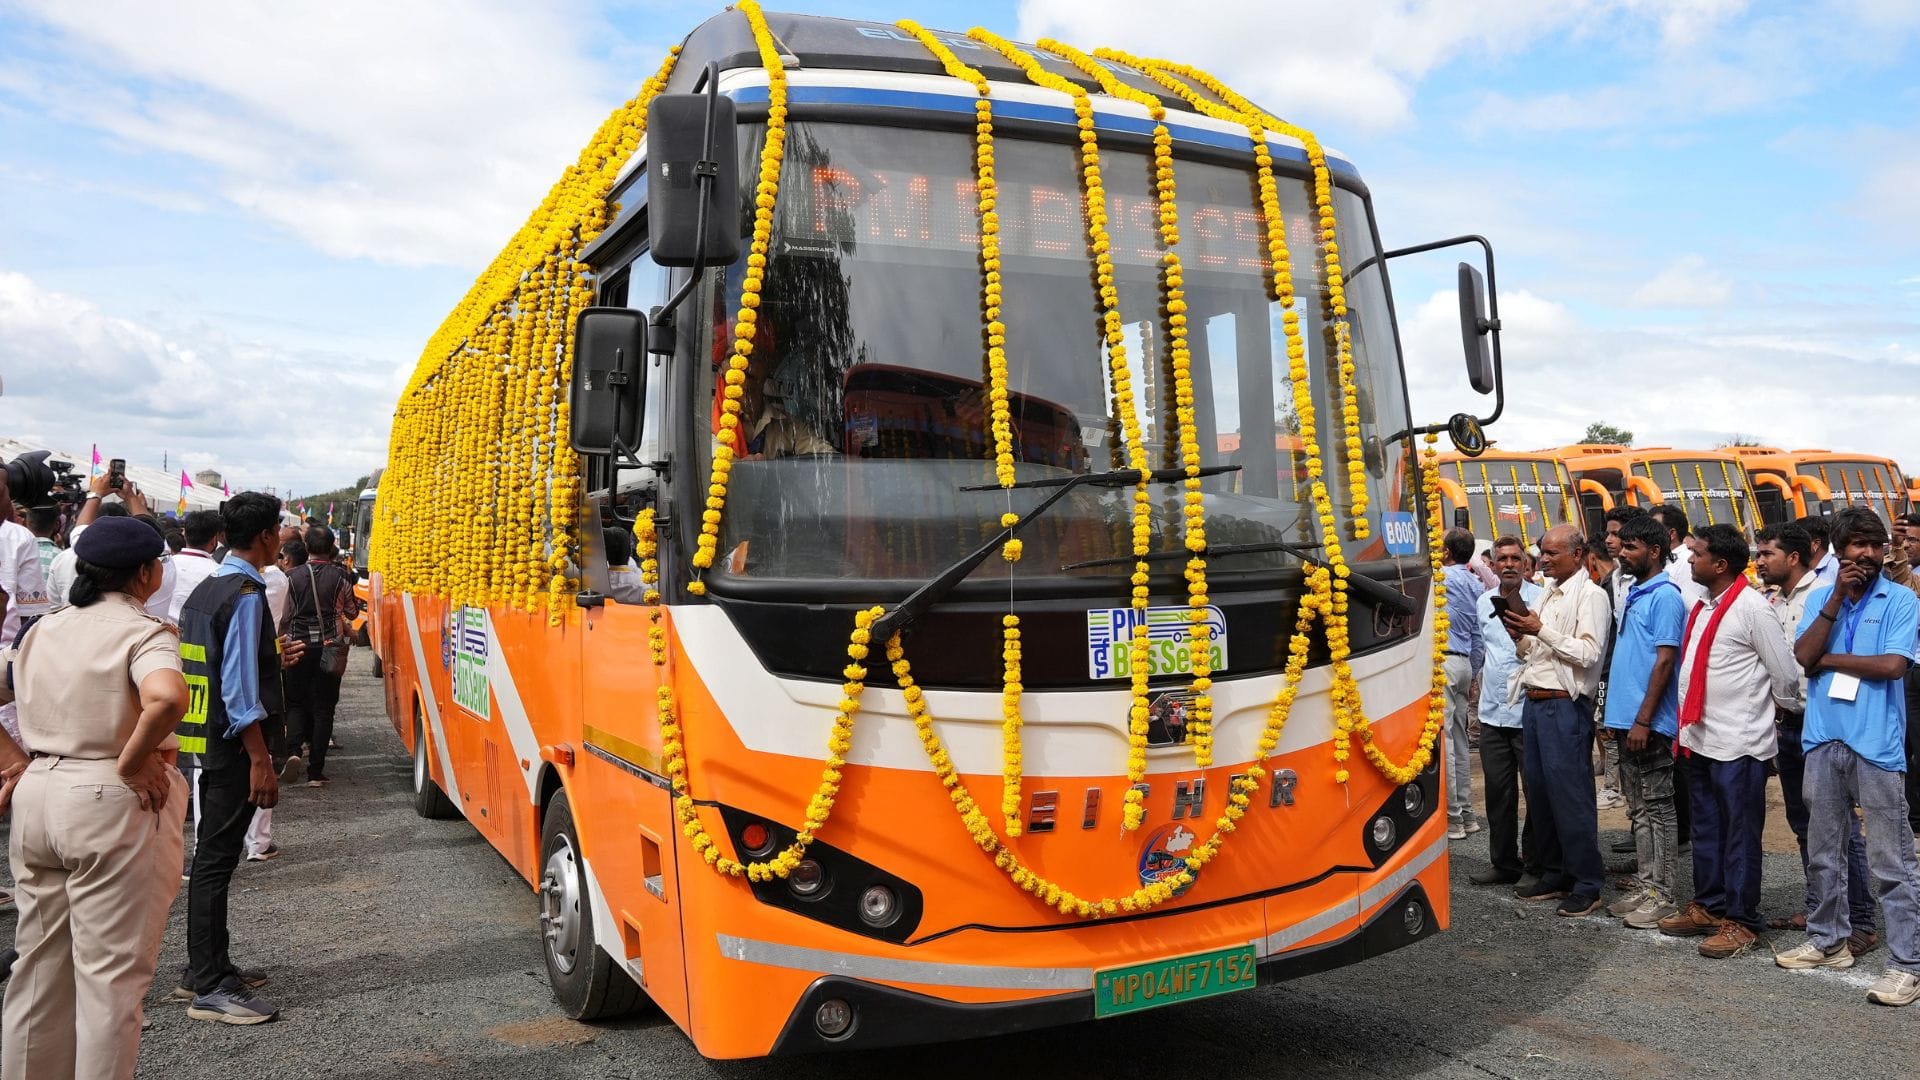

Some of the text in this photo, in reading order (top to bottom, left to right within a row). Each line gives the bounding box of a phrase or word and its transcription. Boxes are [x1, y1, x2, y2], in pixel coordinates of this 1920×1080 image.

[814, 168, 929, 239] PM
[1160, 640, 1222, 674] Sea
[1112, 952, 1254, 1006] MP04WF7152
